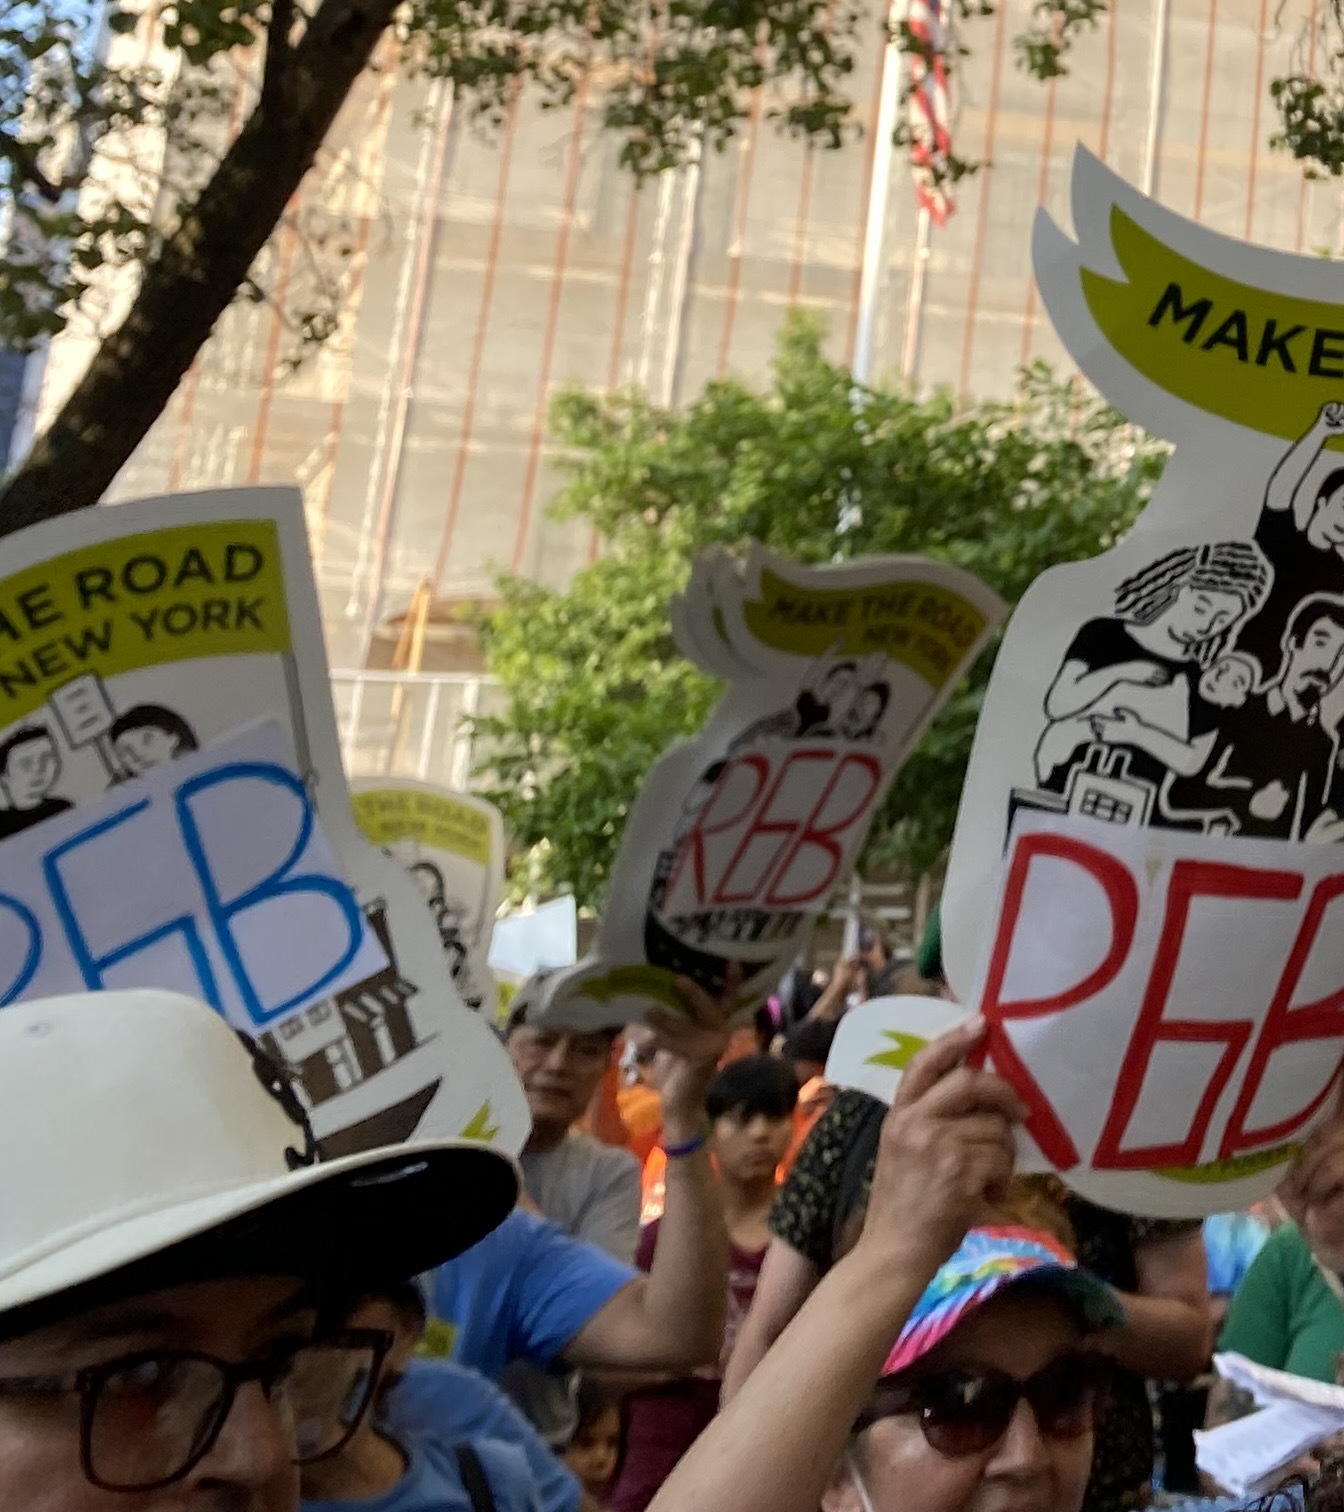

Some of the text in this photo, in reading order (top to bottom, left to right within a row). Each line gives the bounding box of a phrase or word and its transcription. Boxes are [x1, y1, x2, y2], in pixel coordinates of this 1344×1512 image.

[76, 543, 263, 610] ROAD
[0, 596, 265, 699] NEW YORK
